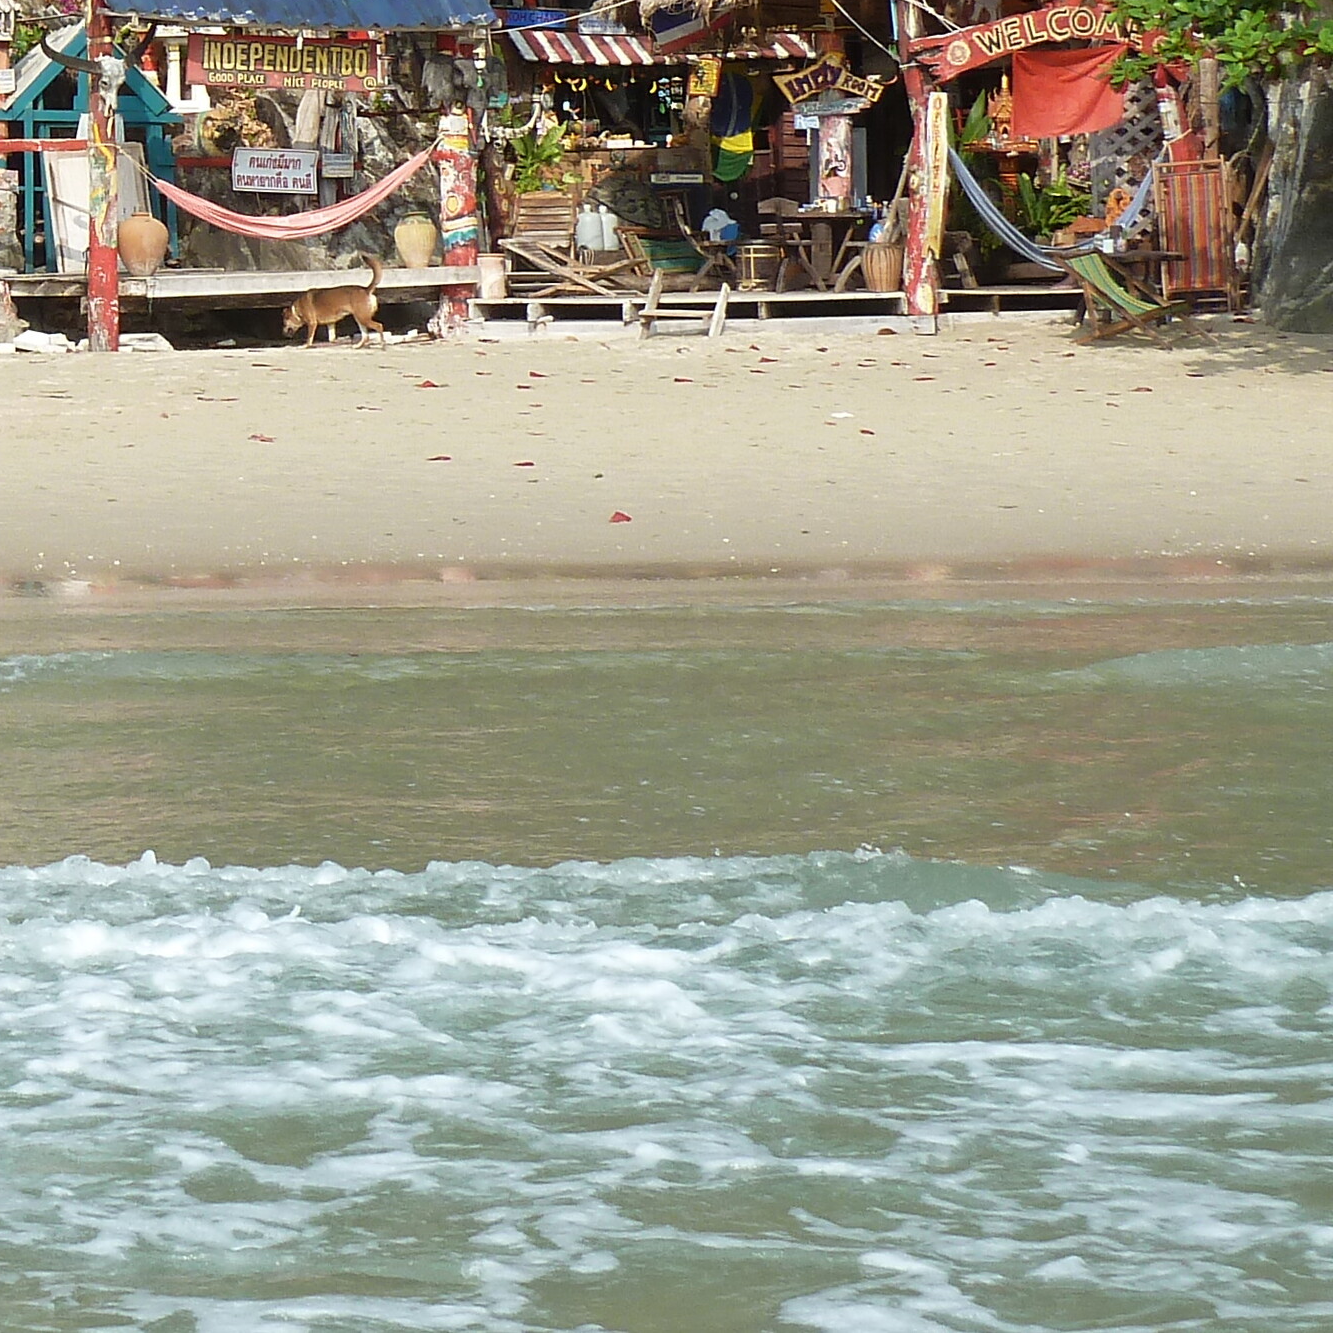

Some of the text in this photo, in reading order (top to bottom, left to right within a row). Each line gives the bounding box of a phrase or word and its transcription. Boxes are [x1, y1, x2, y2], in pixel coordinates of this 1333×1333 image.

[208, 71, 234, 84] GOOD
[237, 72, 266, 85] PLACE
[842, 74, 879, 101] ROOM
